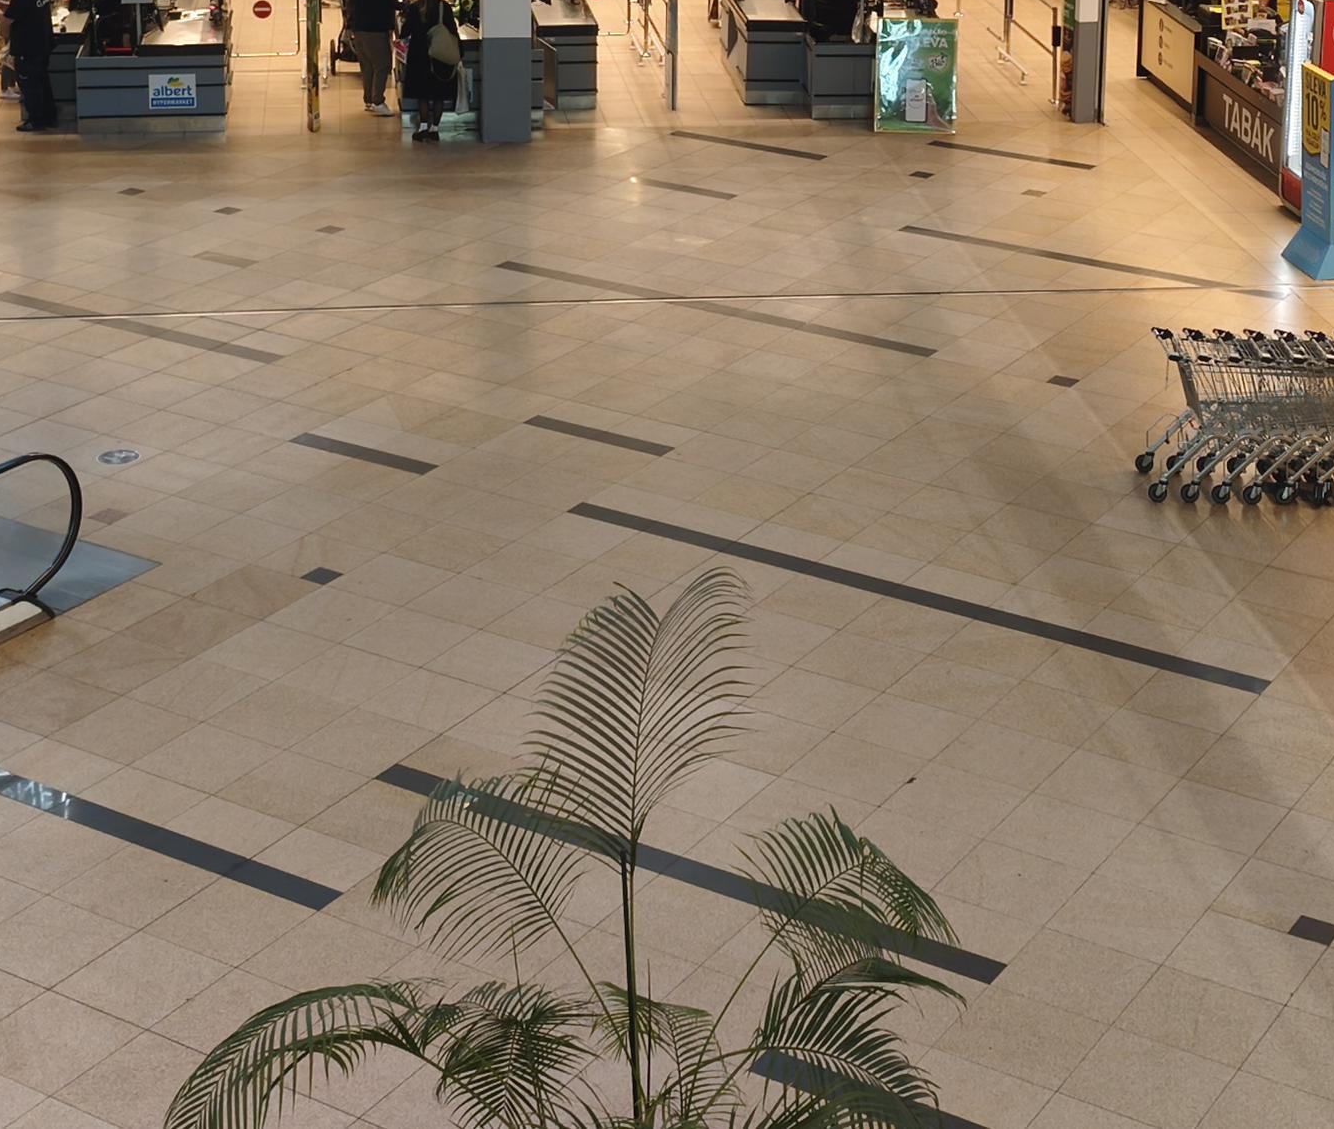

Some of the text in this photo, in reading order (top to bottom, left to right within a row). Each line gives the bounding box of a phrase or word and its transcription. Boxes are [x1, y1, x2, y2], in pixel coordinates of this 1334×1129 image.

[152, 84, 193, 98] albert
[1304, 69, 1327, 100] SLEVA
[1223, 93, 1275, 164] TABÁK
